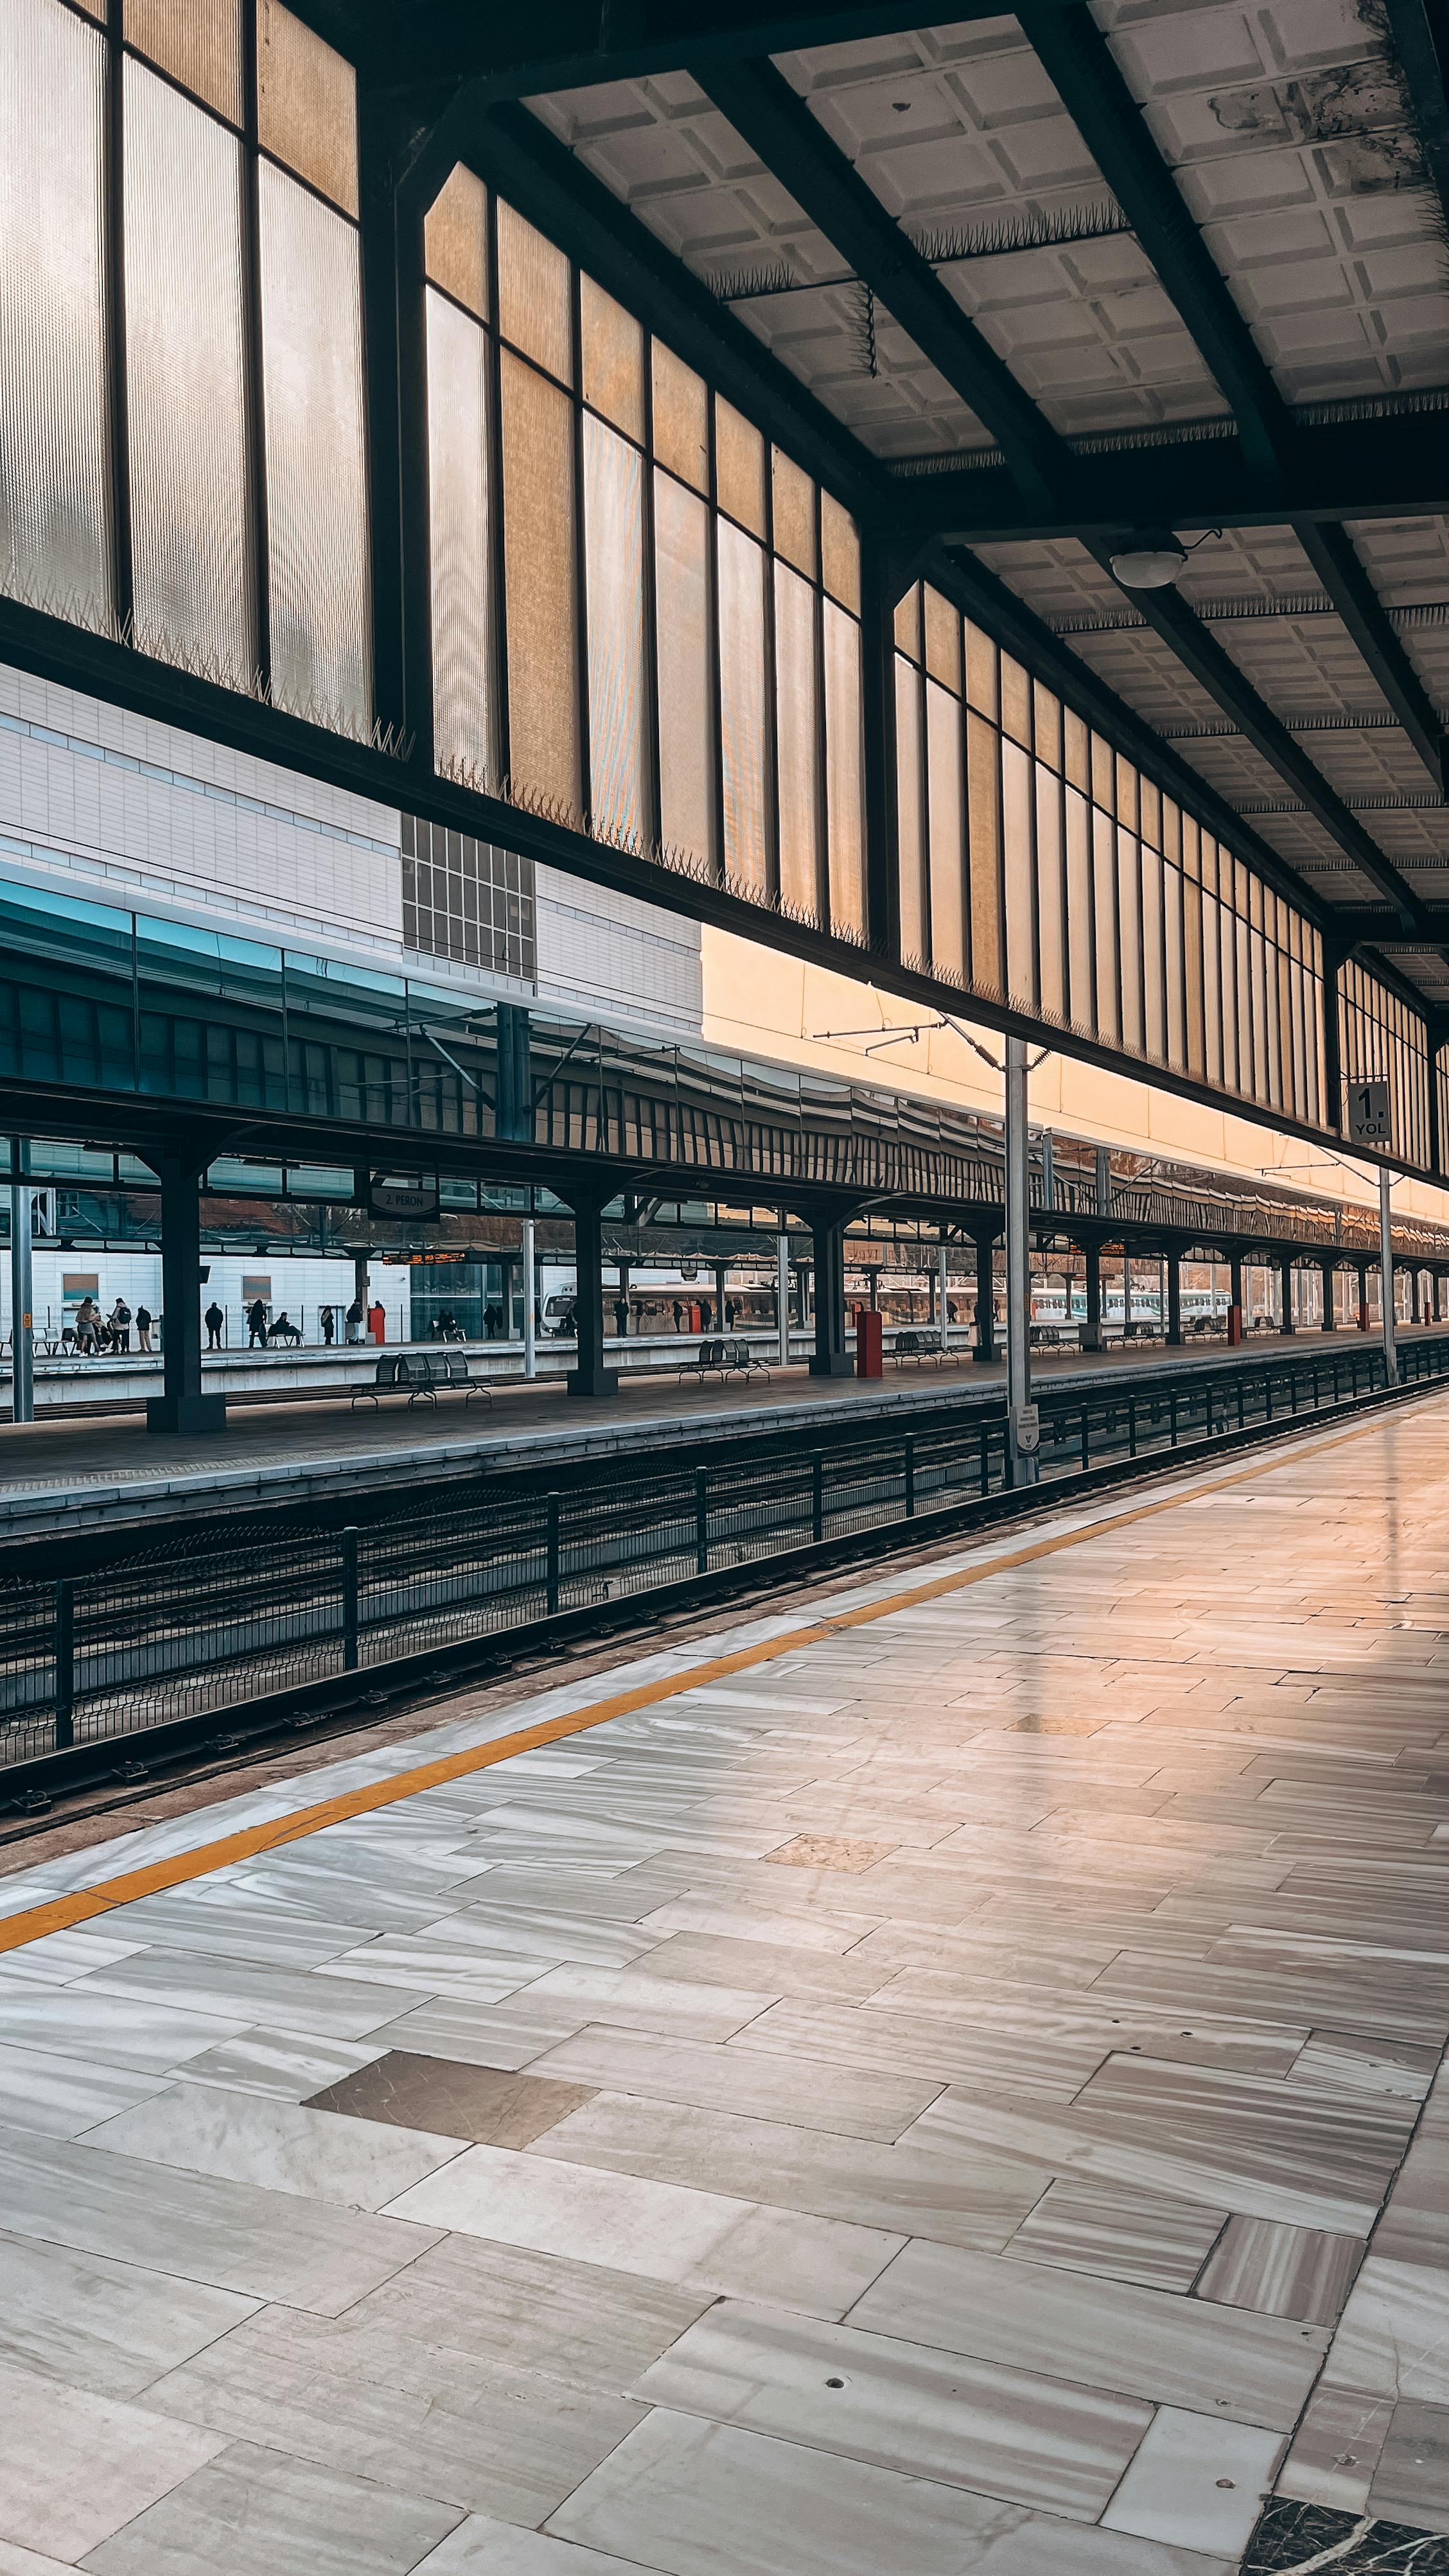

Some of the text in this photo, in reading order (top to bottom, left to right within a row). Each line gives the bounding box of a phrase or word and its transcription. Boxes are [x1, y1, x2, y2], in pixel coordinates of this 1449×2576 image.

[1358, 1088, 1384, 1119] 1.
[1355, 1123, 1387, 1135] YOL
[396, 1195, 423, 1207] PERON
